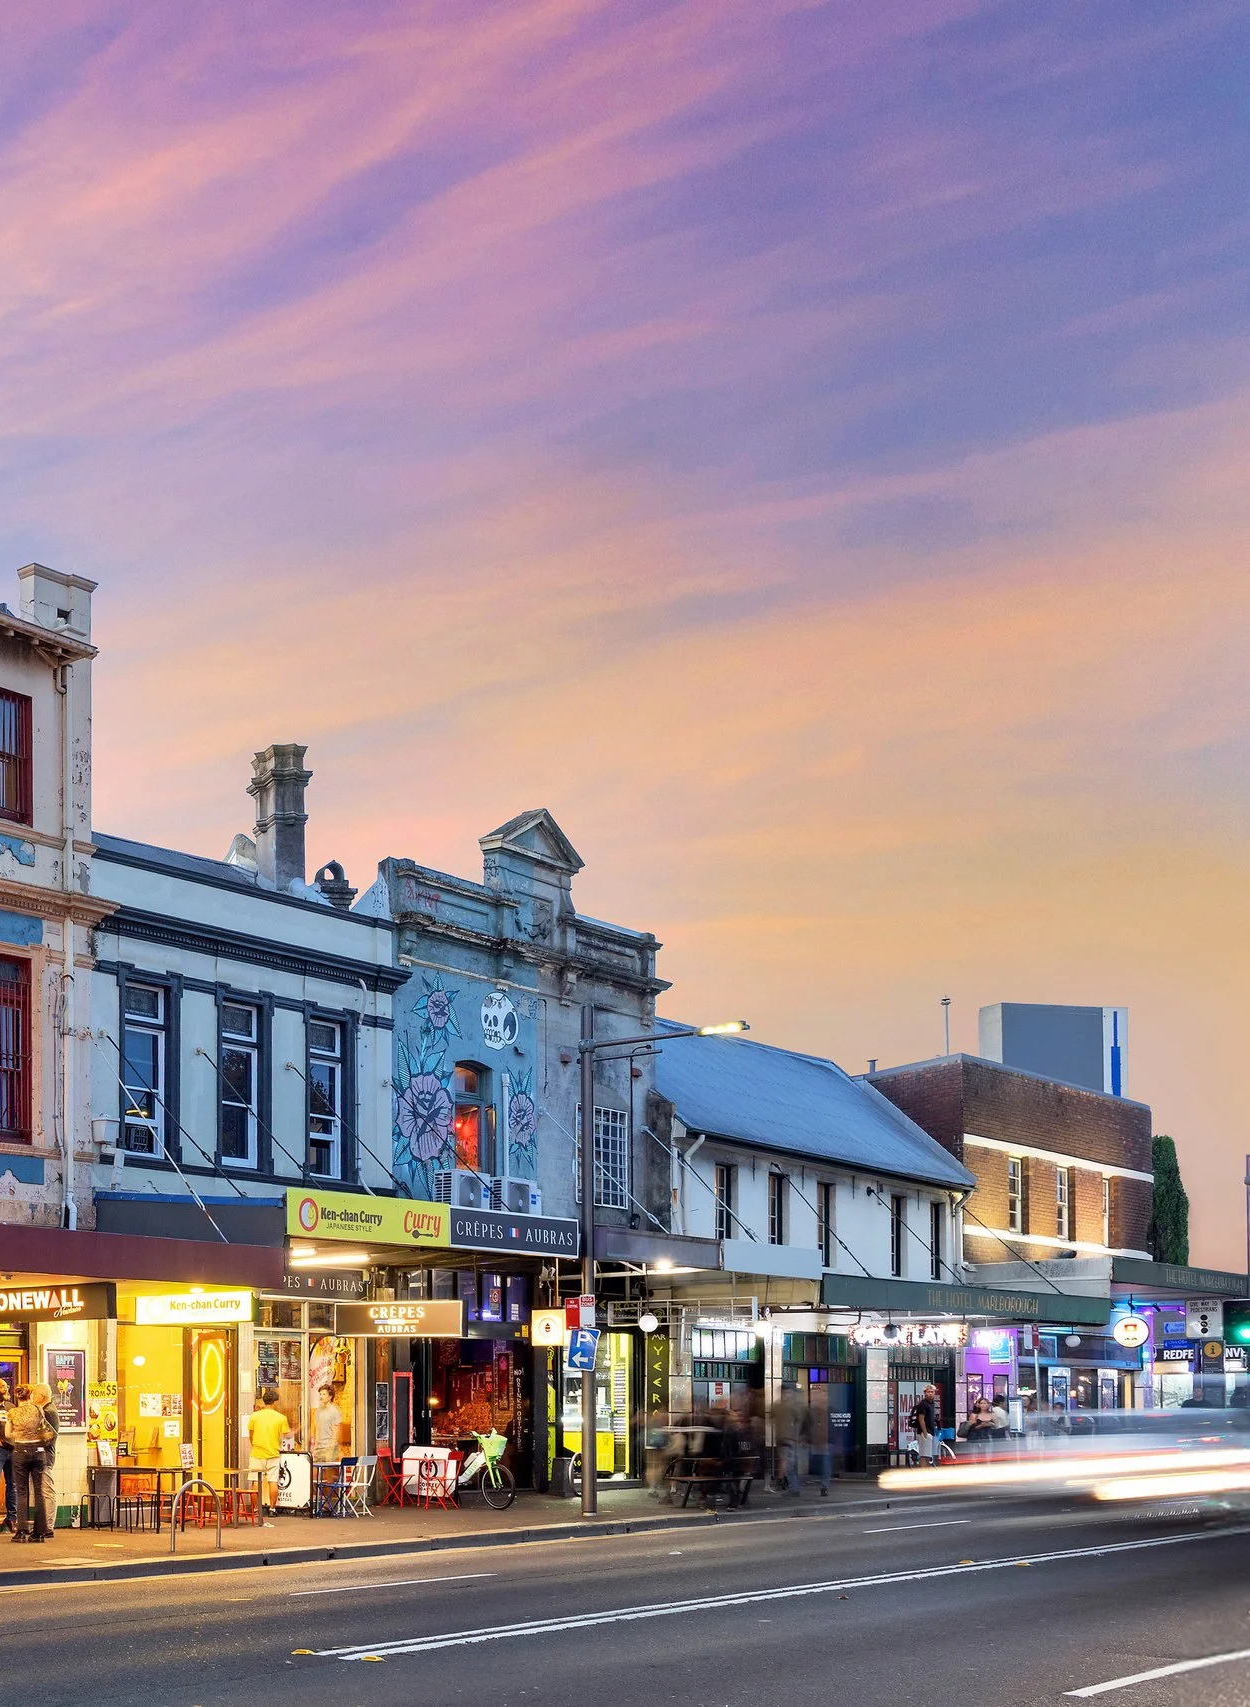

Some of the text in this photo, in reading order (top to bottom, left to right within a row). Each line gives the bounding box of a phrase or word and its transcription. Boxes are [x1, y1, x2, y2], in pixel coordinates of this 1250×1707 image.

[320, 1206, 383, 1227] Ken-chan Curry
[326, 1222, 372, 1233] JAPANESE STYLE
[403, 1209, 442, 1238] Curry
[456, 1219, 574, 1247] CRÊPES AUBRAS
[320, 1278, 364, 1292] AUBRAS
[170, 1298, 241, 1311] Ken-chan Curry
[927, 1289, 1039, 1315] THE HOTEL MARLBOROUGH
[369, 1306, 425, 1319] CRÊPES
[377, 1325, 416, 1333] AUBRAS
[106, 1384, 117, 1396] $5
